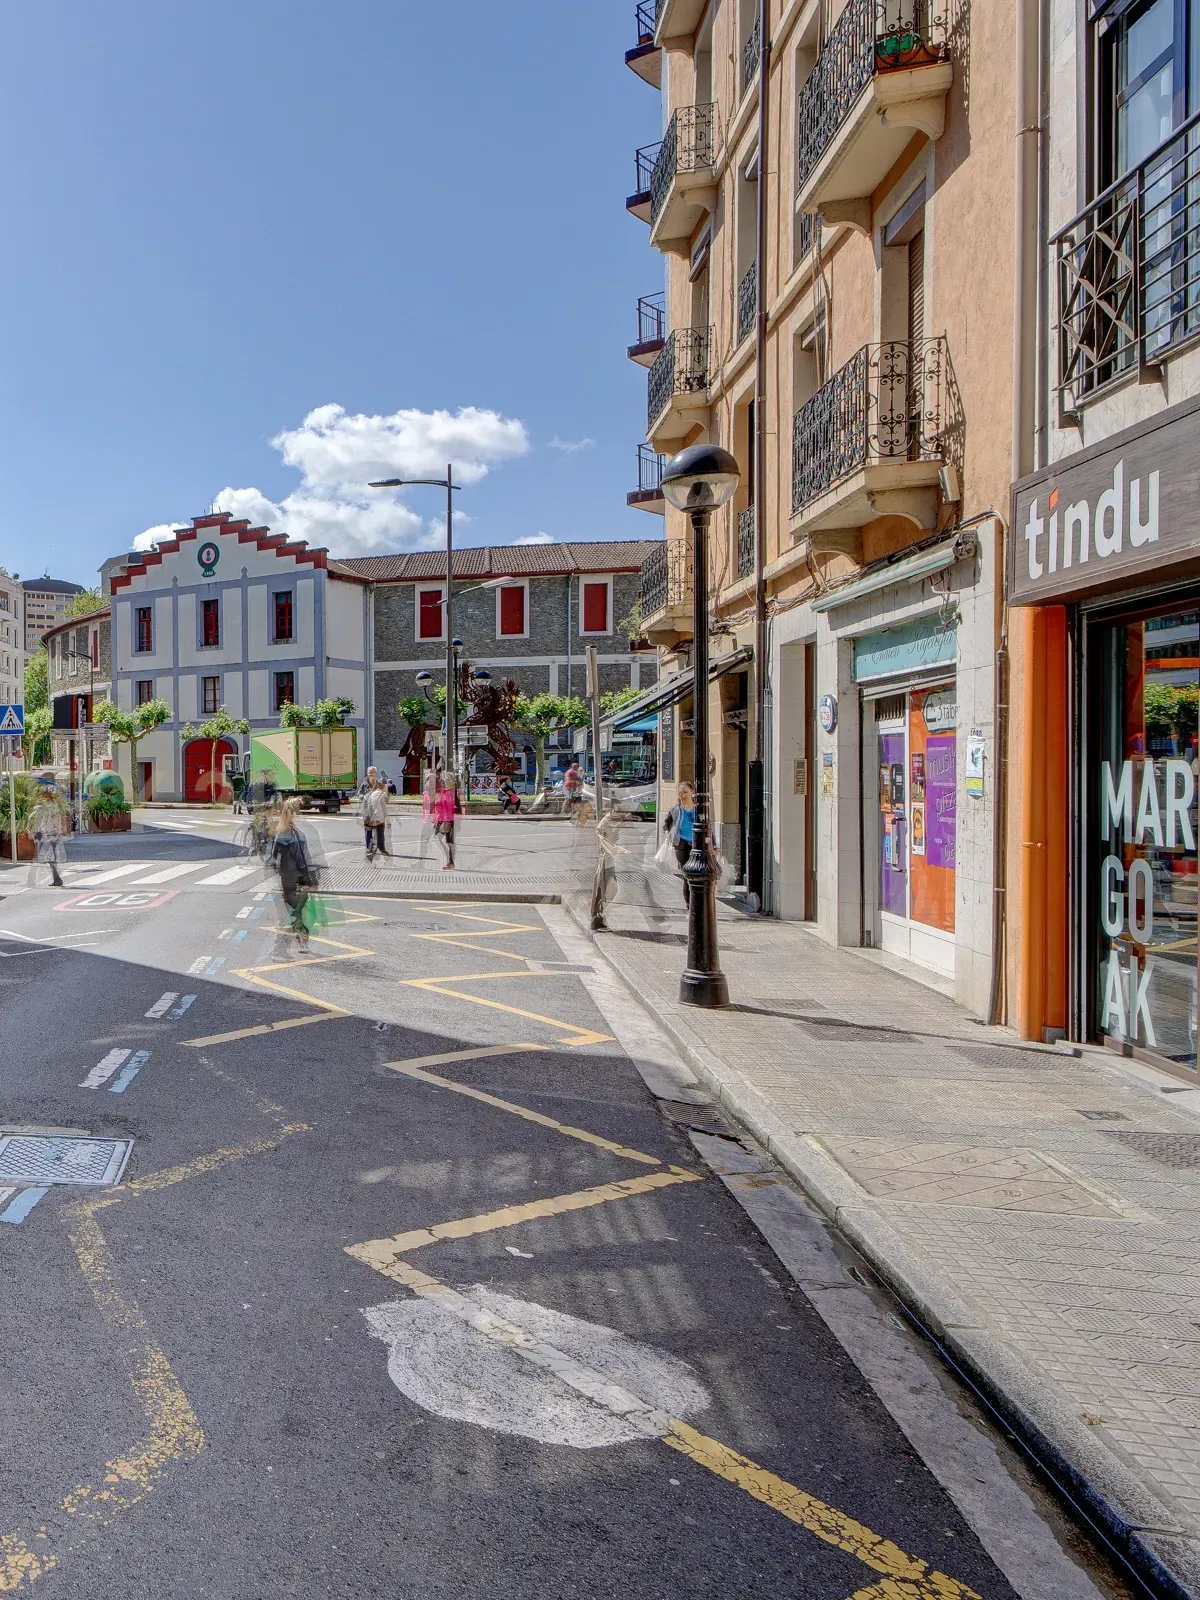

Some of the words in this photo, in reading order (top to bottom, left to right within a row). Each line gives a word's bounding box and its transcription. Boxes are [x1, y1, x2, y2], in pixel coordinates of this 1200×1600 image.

[1025, 457, 1160, 580] tindu
[1101, 760, 1197, 850] MAR
[1101, 854, 1154, 944] GO
[1101, 950, 1158, 1047] AK
